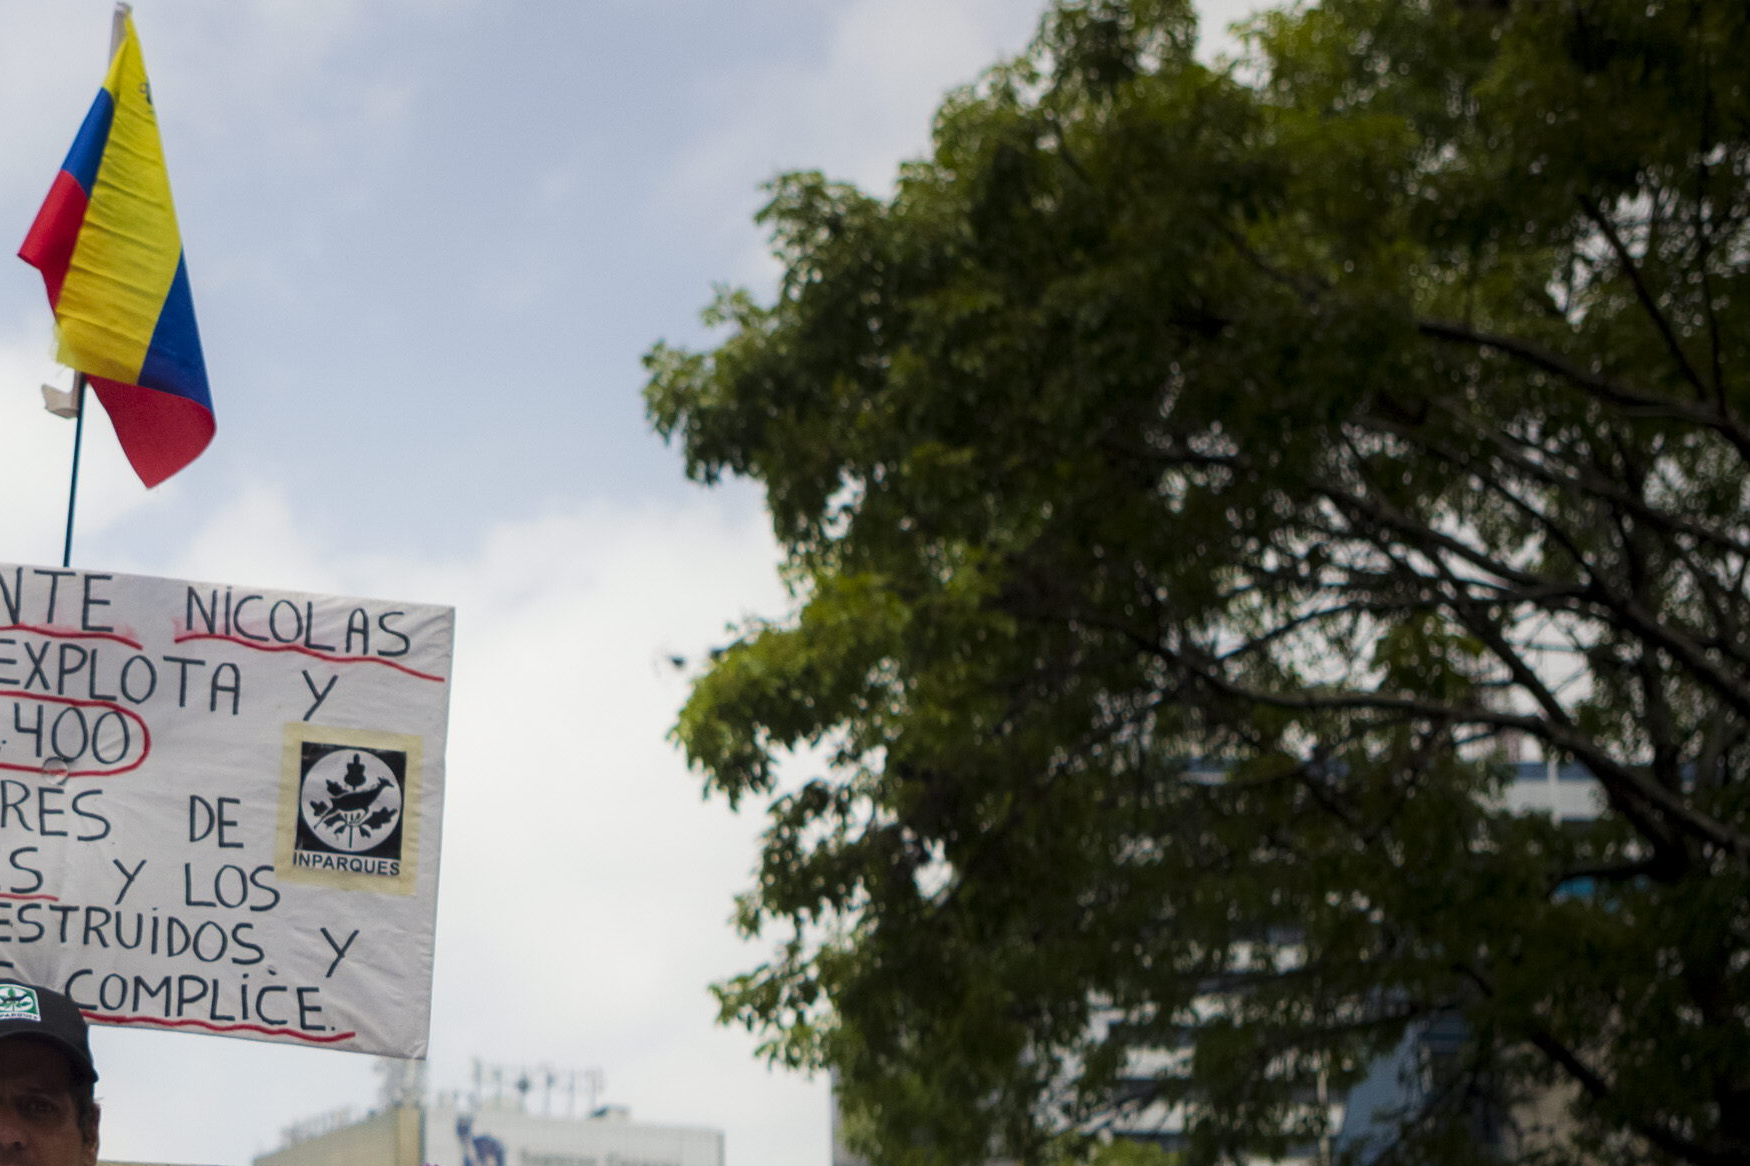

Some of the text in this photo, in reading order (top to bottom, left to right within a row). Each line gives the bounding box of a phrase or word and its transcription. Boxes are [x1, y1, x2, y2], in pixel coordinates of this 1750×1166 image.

[186, 585, 410, 657] NICOLAS
[302, 670, 338, 721] Y
[189, 795, 244, 848] DE
[113, 859, 146, 905] Y
[185, 863, 280, 912] LOS
[293, 852, 400, 877] INPARQUES
[320, 928, 359, 978] Y
